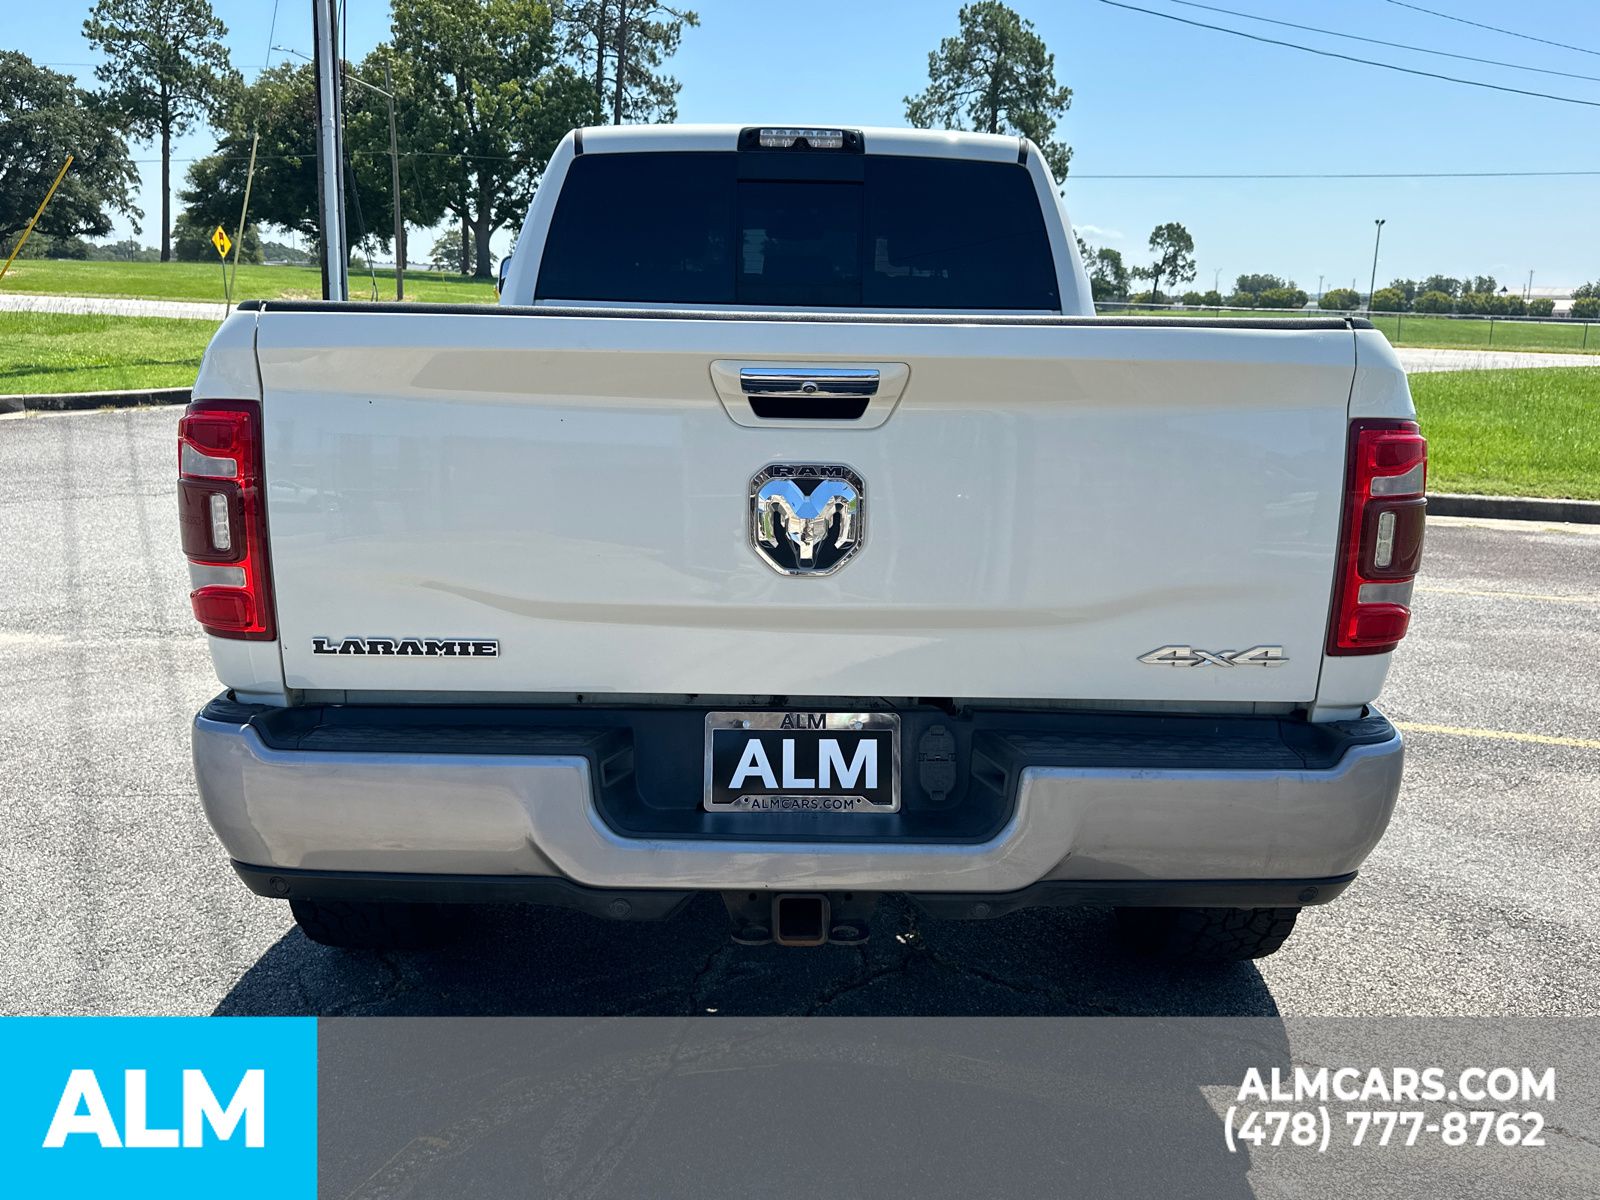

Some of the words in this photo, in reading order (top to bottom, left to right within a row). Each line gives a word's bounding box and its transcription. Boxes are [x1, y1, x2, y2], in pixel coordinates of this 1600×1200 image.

[773, 466, 843, 477] RAM
[312, 638, 499, 657] LARAMIE
[780, 714, 827, 729] ALM
[728, 738, 878, 789] ALM
[751, 798, 854, 810] ALMCARS.COM
